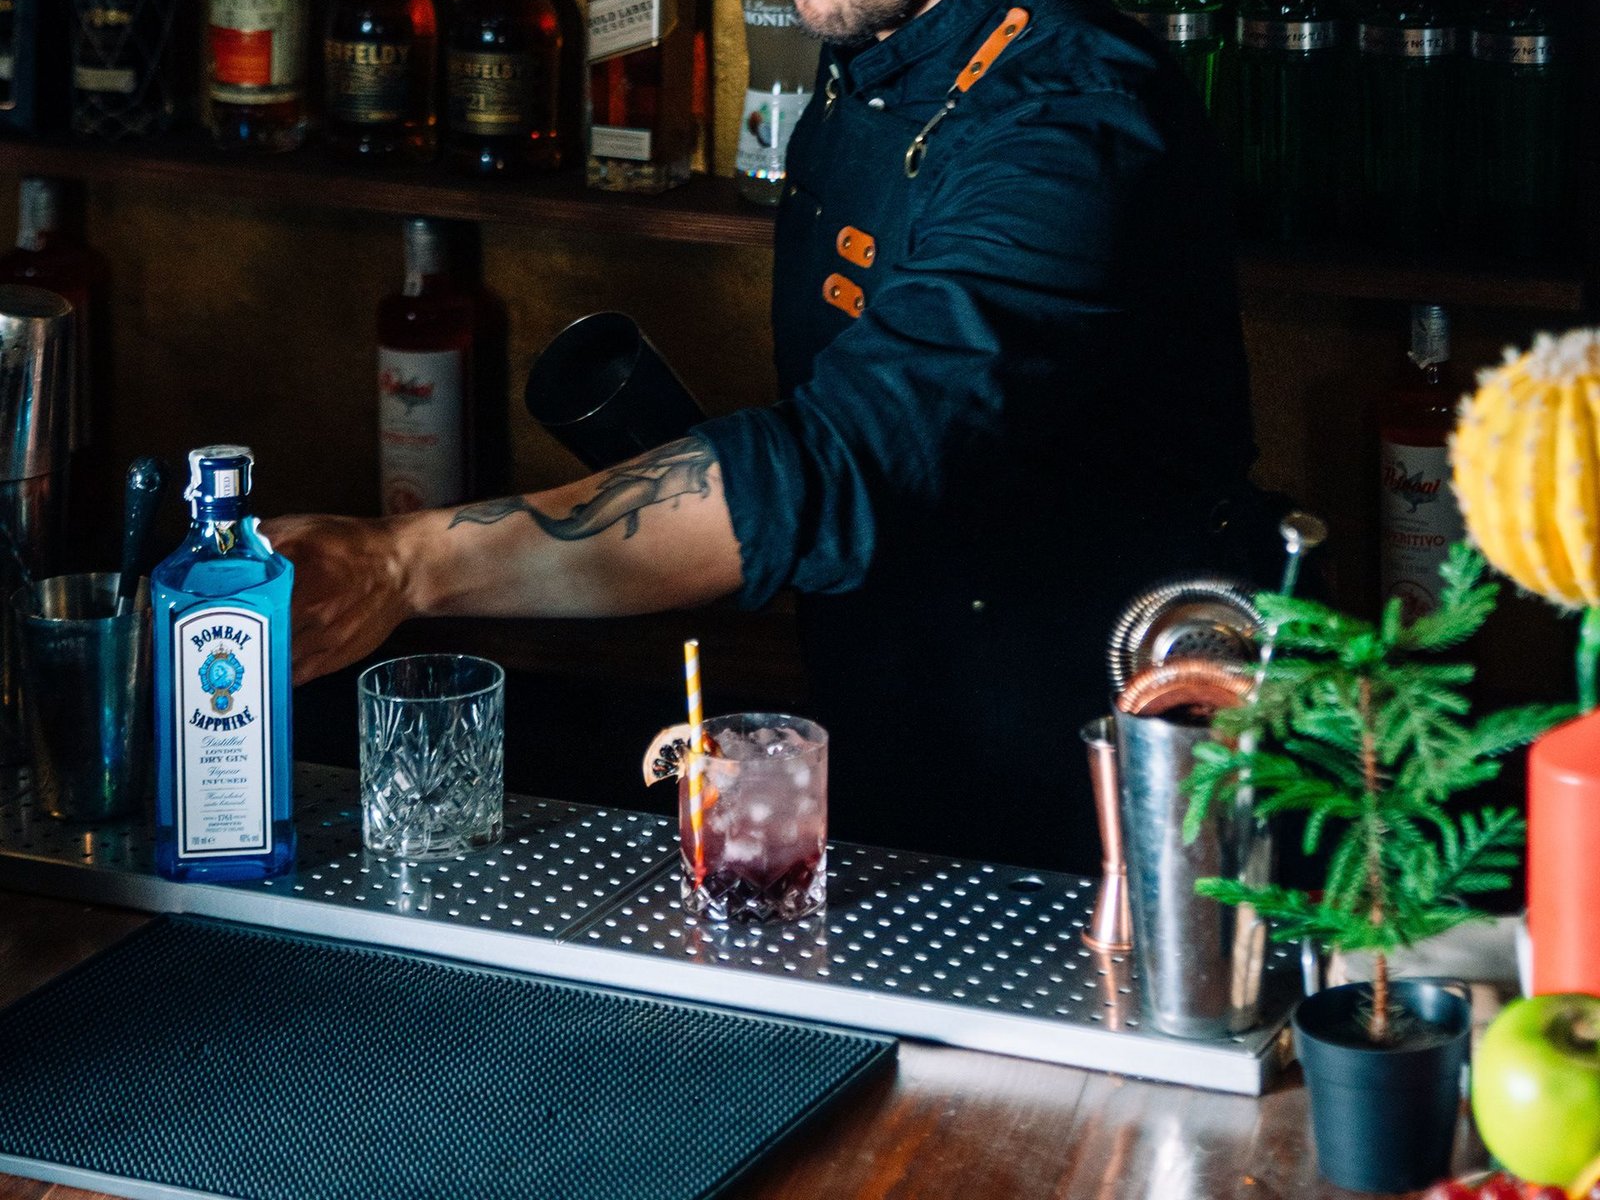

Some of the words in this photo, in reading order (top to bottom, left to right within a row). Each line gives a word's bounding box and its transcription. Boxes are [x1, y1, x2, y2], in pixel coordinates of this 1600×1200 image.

[191, 626, 252, 652] BOMBAY
[189, 705, 255, 732] SAPPHIRE
[200, 735, 247, 749] Distilled
[205, 748, 243, 756] LONDON
[200, 756, 223, 764] DRY
[225, 754, 248, 763] GIN
[207, 765, 241, 778] Vapour
[201, 778, 248, 787] INFUSED
